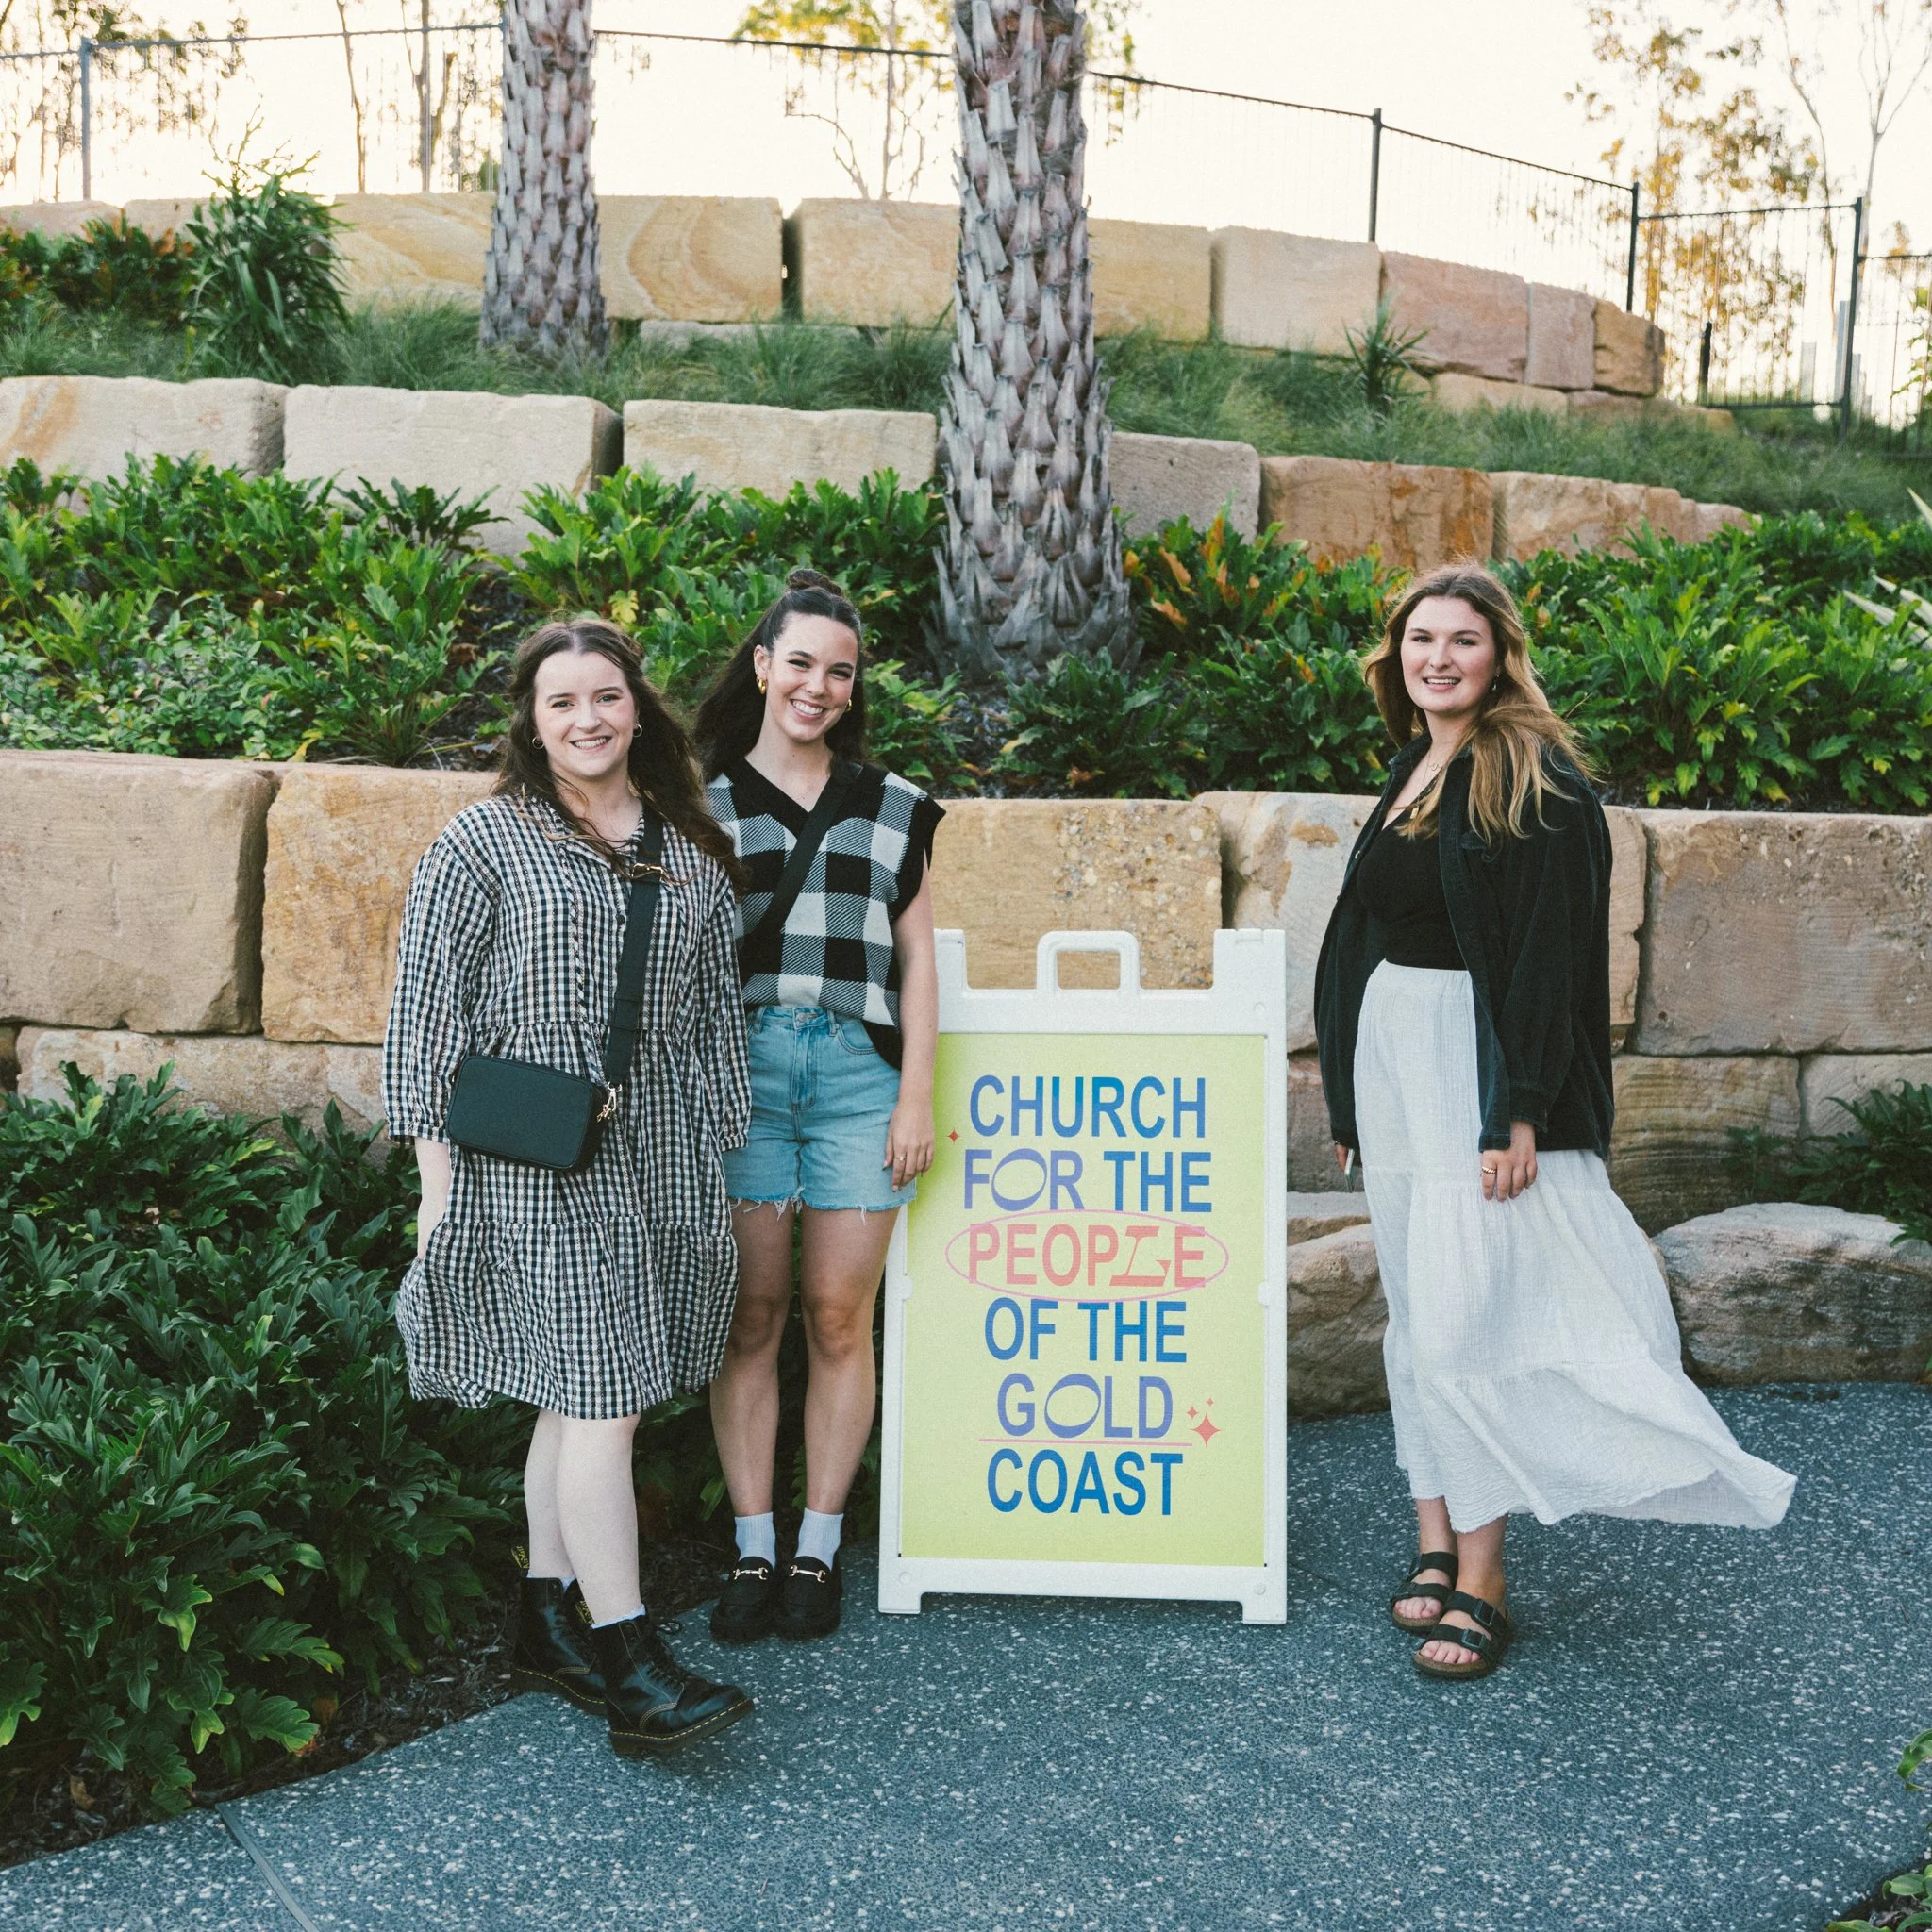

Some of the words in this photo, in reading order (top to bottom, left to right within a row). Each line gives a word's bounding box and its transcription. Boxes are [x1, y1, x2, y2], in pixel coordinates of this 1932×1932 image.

[969, 1074, 1207, 1139] CHURCH
[963, 1148, 1085, 1212] FOR
[1103, 1150, 1213, 1213] THE
[968, 1224, 1208, 1289] PEOPLE
[984, 1297, 1058, 1361] OF
[1077, 1300, 1188, 1364] THE
[996, 1373, 1174, 1440] GOLD
[987, 1447, 1185, 1517] COAST
